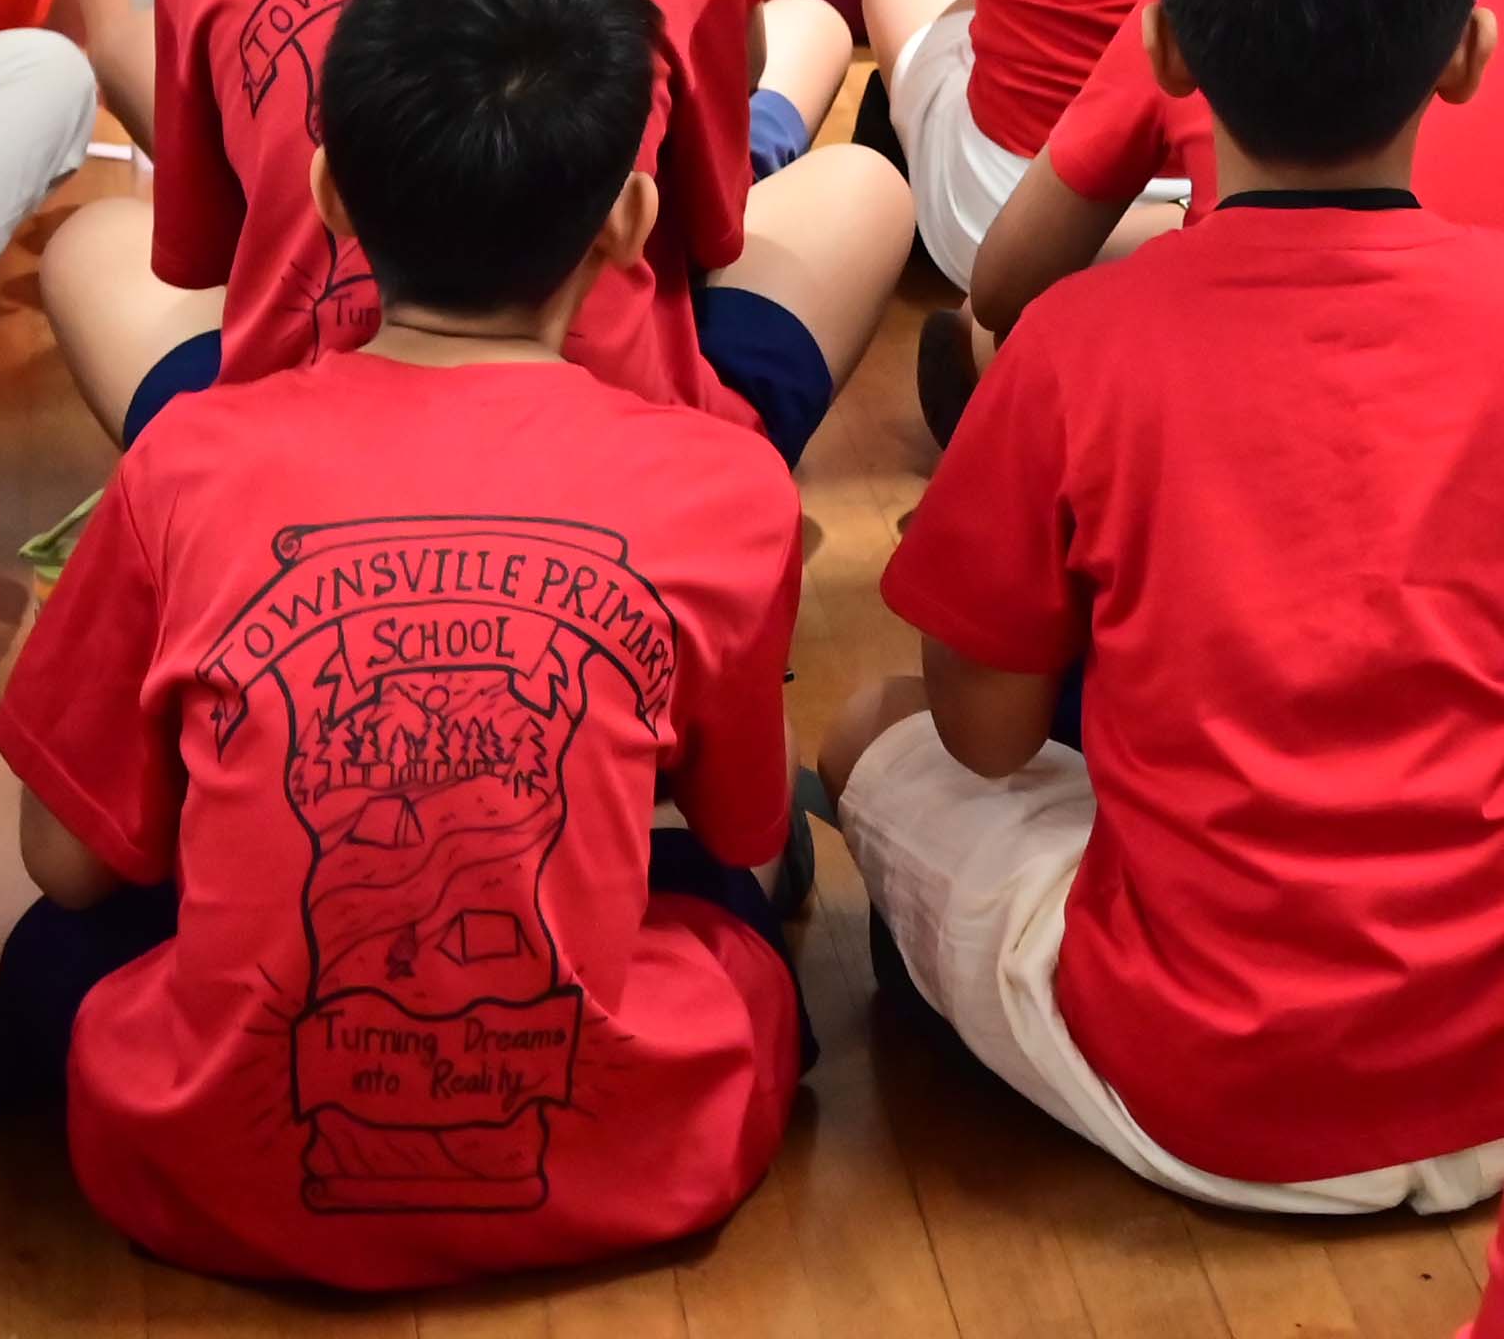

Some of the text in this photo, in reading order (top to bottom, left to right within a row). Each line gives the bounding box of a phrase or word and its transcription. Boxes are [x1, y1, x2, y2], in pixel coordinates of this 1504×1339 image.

[206, 548, 676, 691] TOWNSVILLE PRIMARY
[367, 615, 516, 669] SCHOOL
[316, 1009, 568, 1069] Turning Dreams
[429, 1058, 549, 1114] Reality
